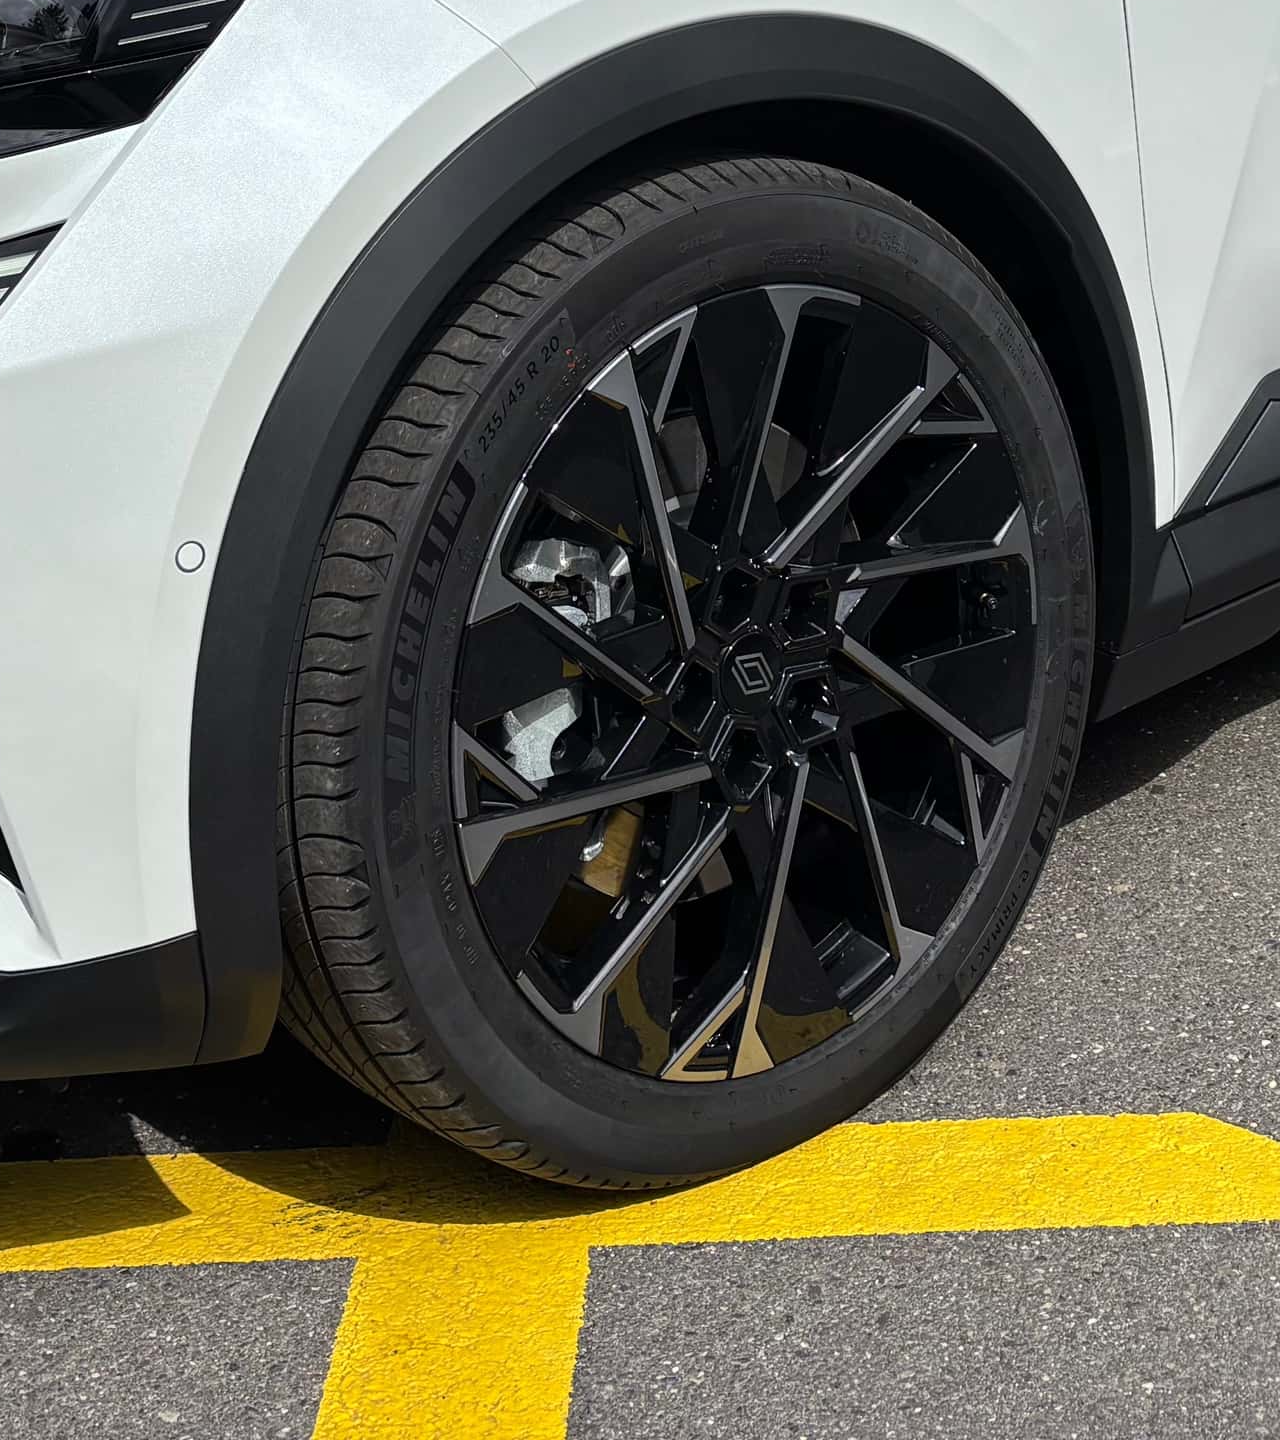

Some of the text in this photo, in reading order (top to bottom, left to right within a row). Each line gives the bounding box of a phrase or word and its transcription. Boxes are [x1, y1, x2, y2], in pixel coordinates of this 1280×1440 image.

[478, 335, 560, 454] 235/45 R 20
[384, 479, 466, 783] MICHELIN
